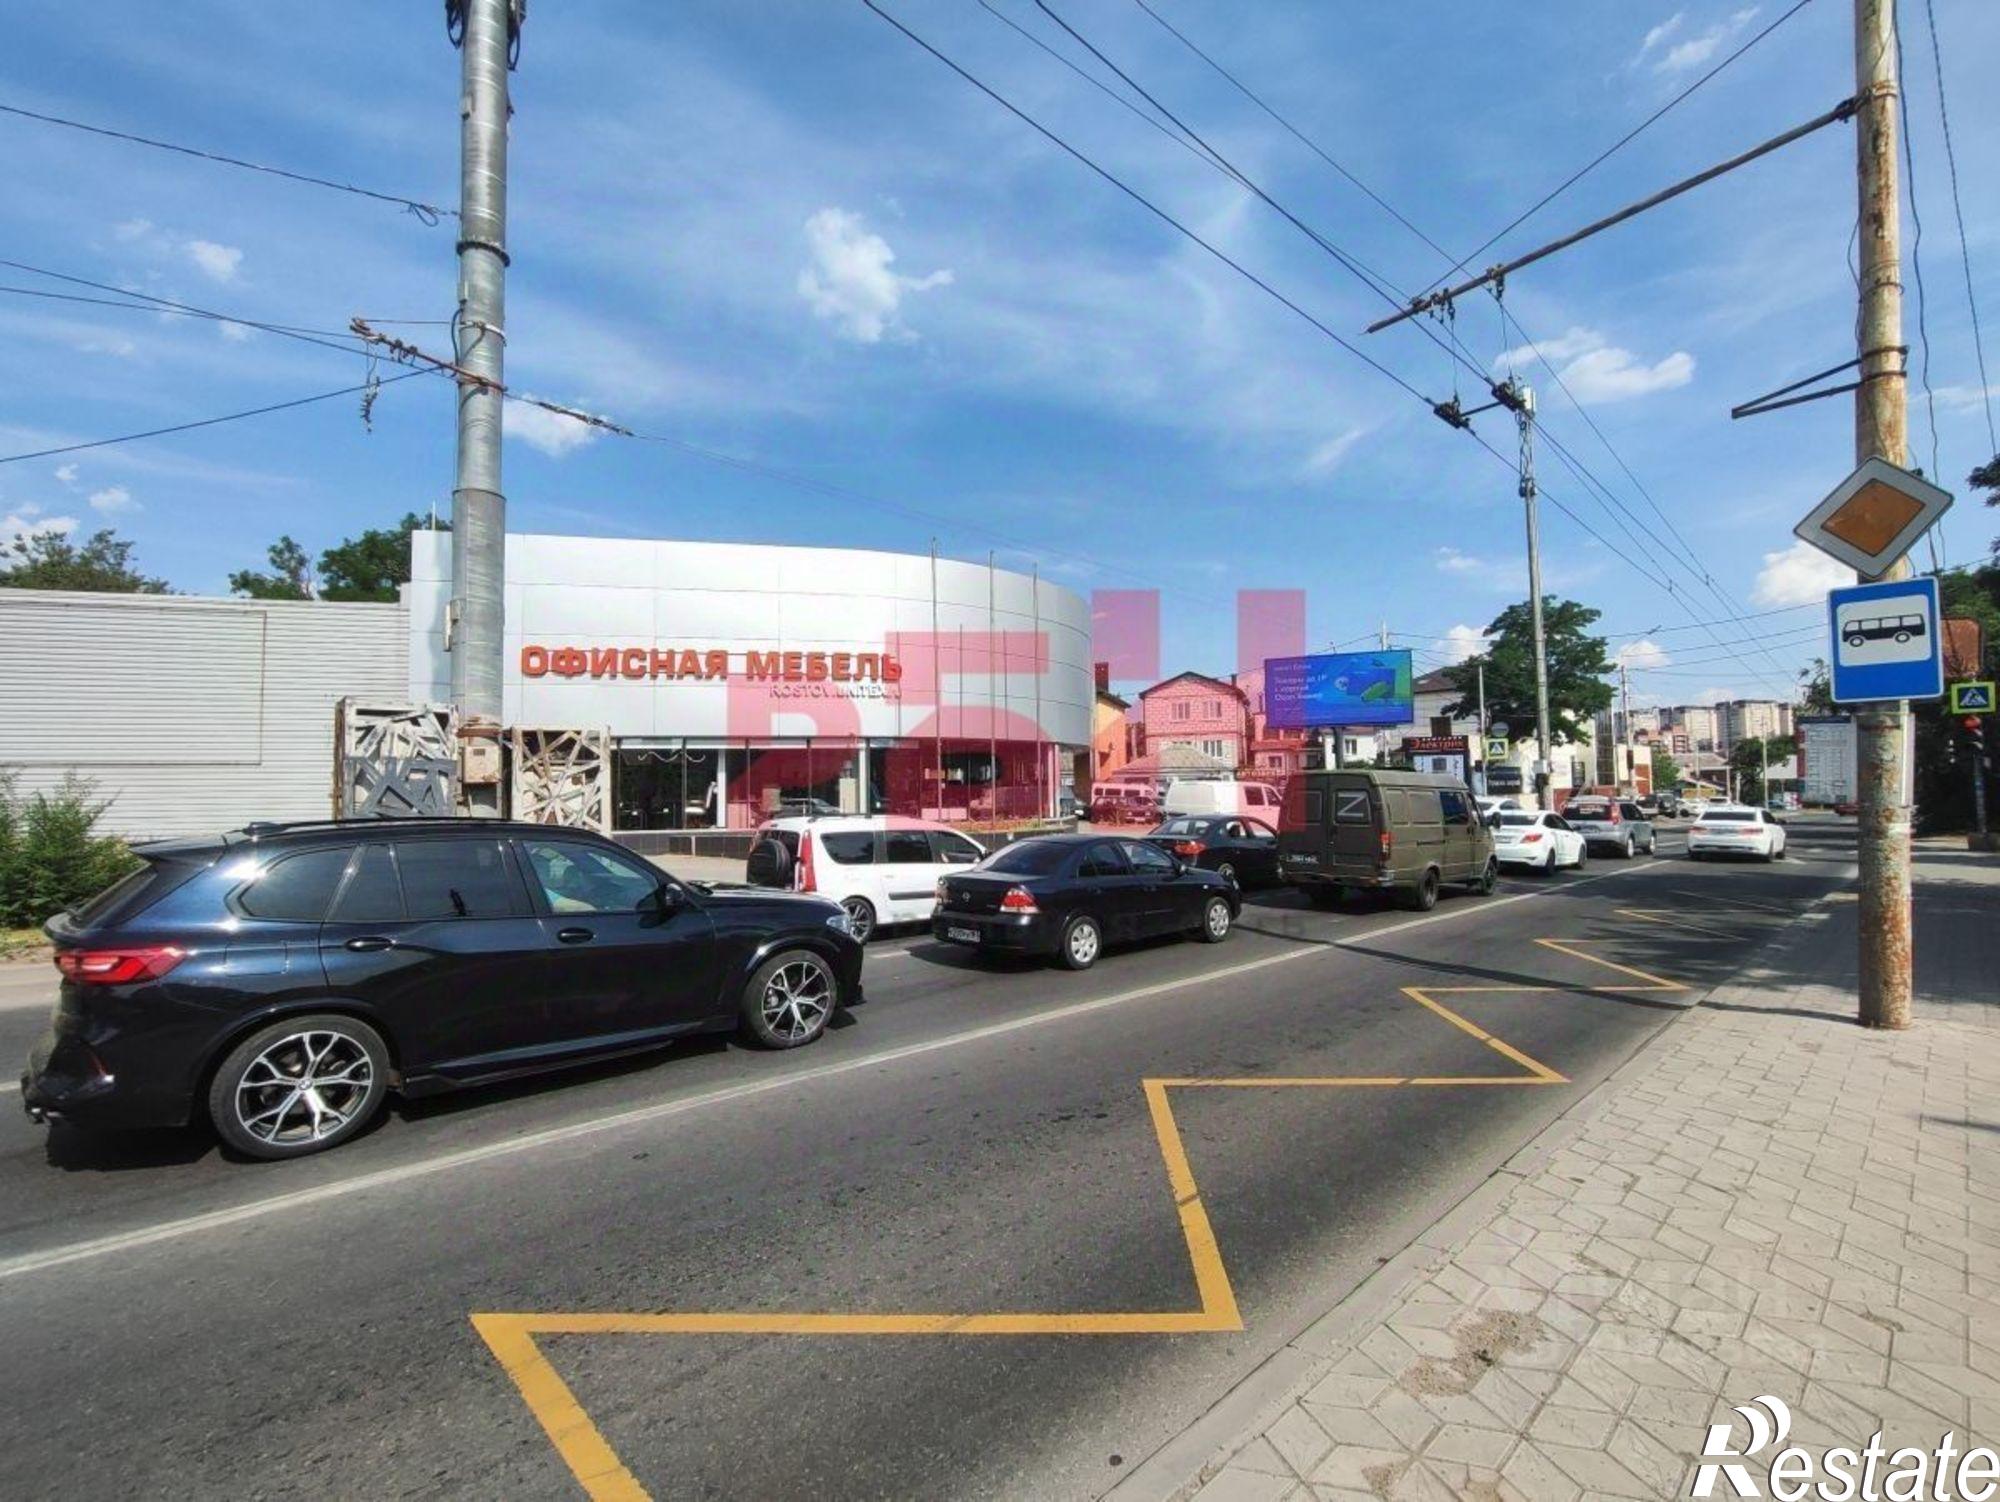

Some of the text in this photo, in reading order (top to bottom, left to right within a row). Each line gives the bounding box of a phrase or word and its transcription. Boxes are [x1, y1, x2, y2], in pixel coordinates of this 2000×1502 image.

[521, 646, 902, 684] ОФИСНАЯ МЕБЕЛЬ
[1337, 791, 1367, 818] Z
